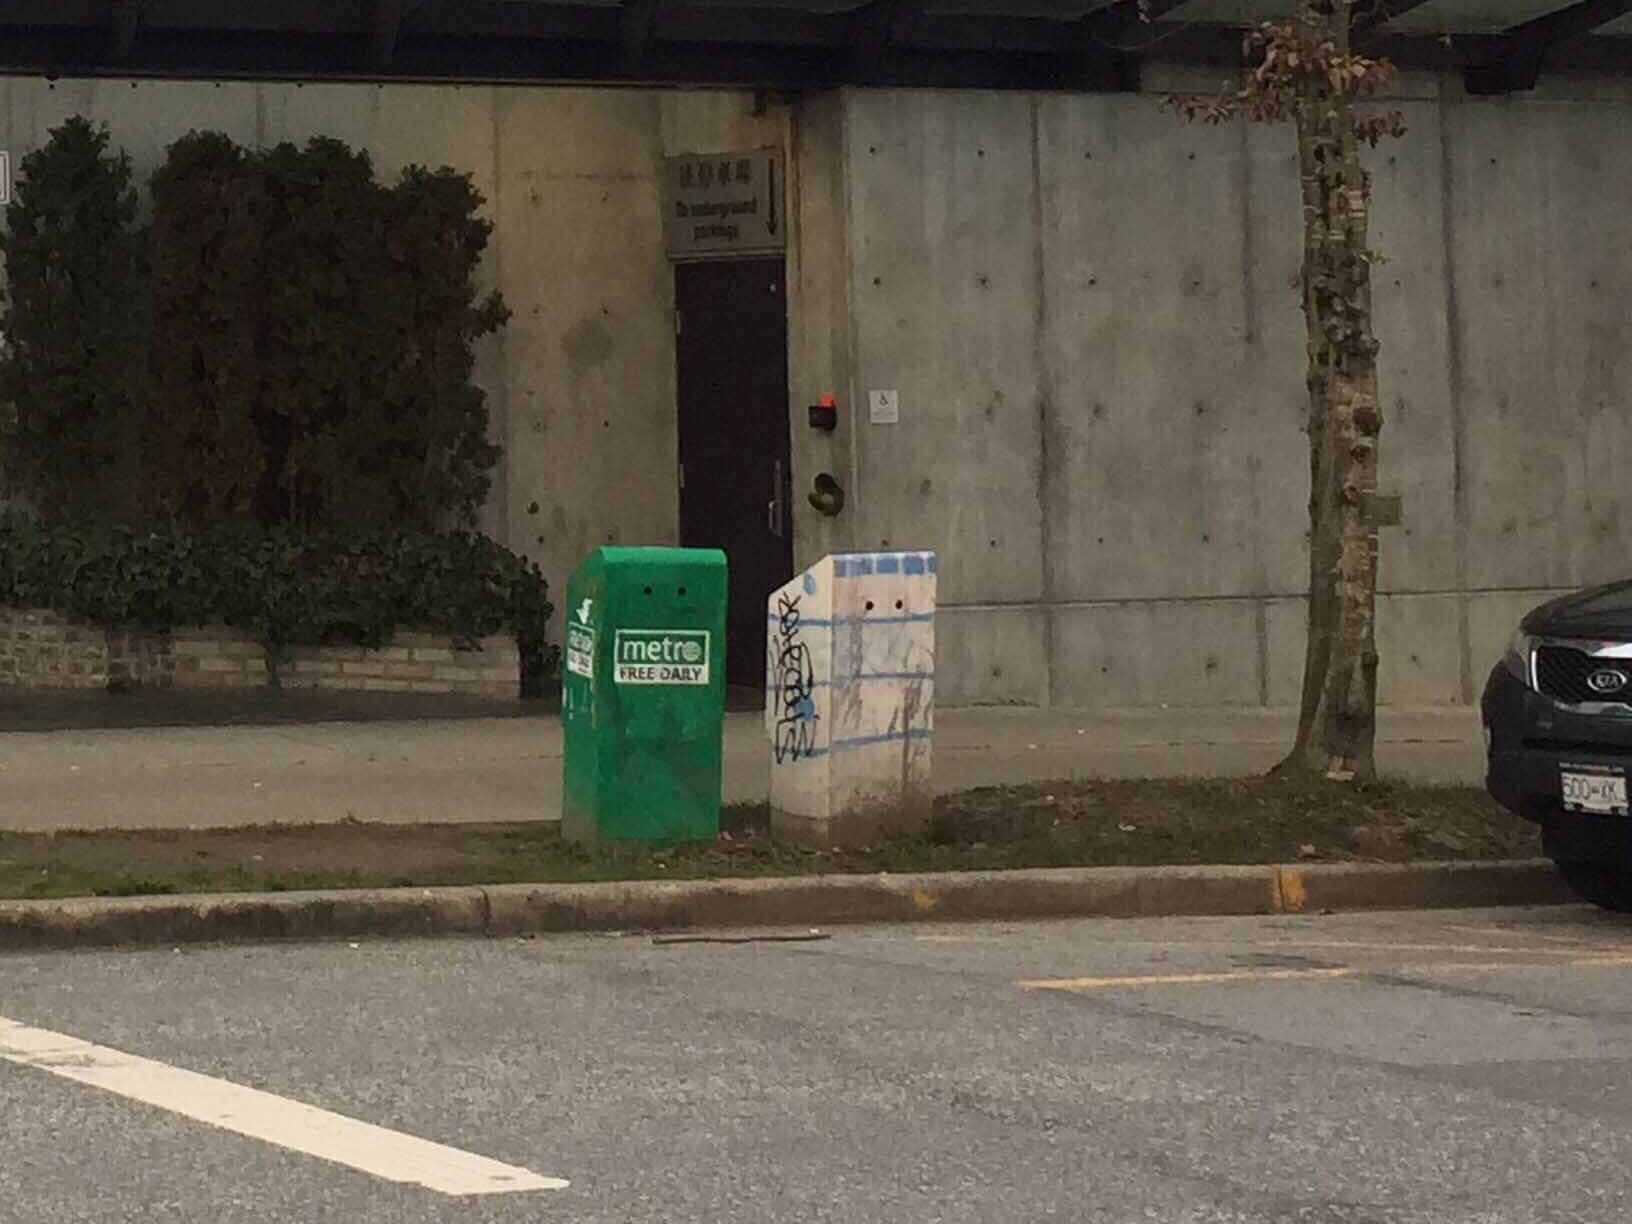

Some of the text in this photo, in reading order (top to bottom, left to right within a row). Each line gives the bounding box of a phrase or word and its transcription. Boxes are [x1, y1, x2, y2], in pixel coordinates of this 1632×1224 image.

[622, 636, 702, 663] metro
[619, 665, 702, 681] FREE DAILY
